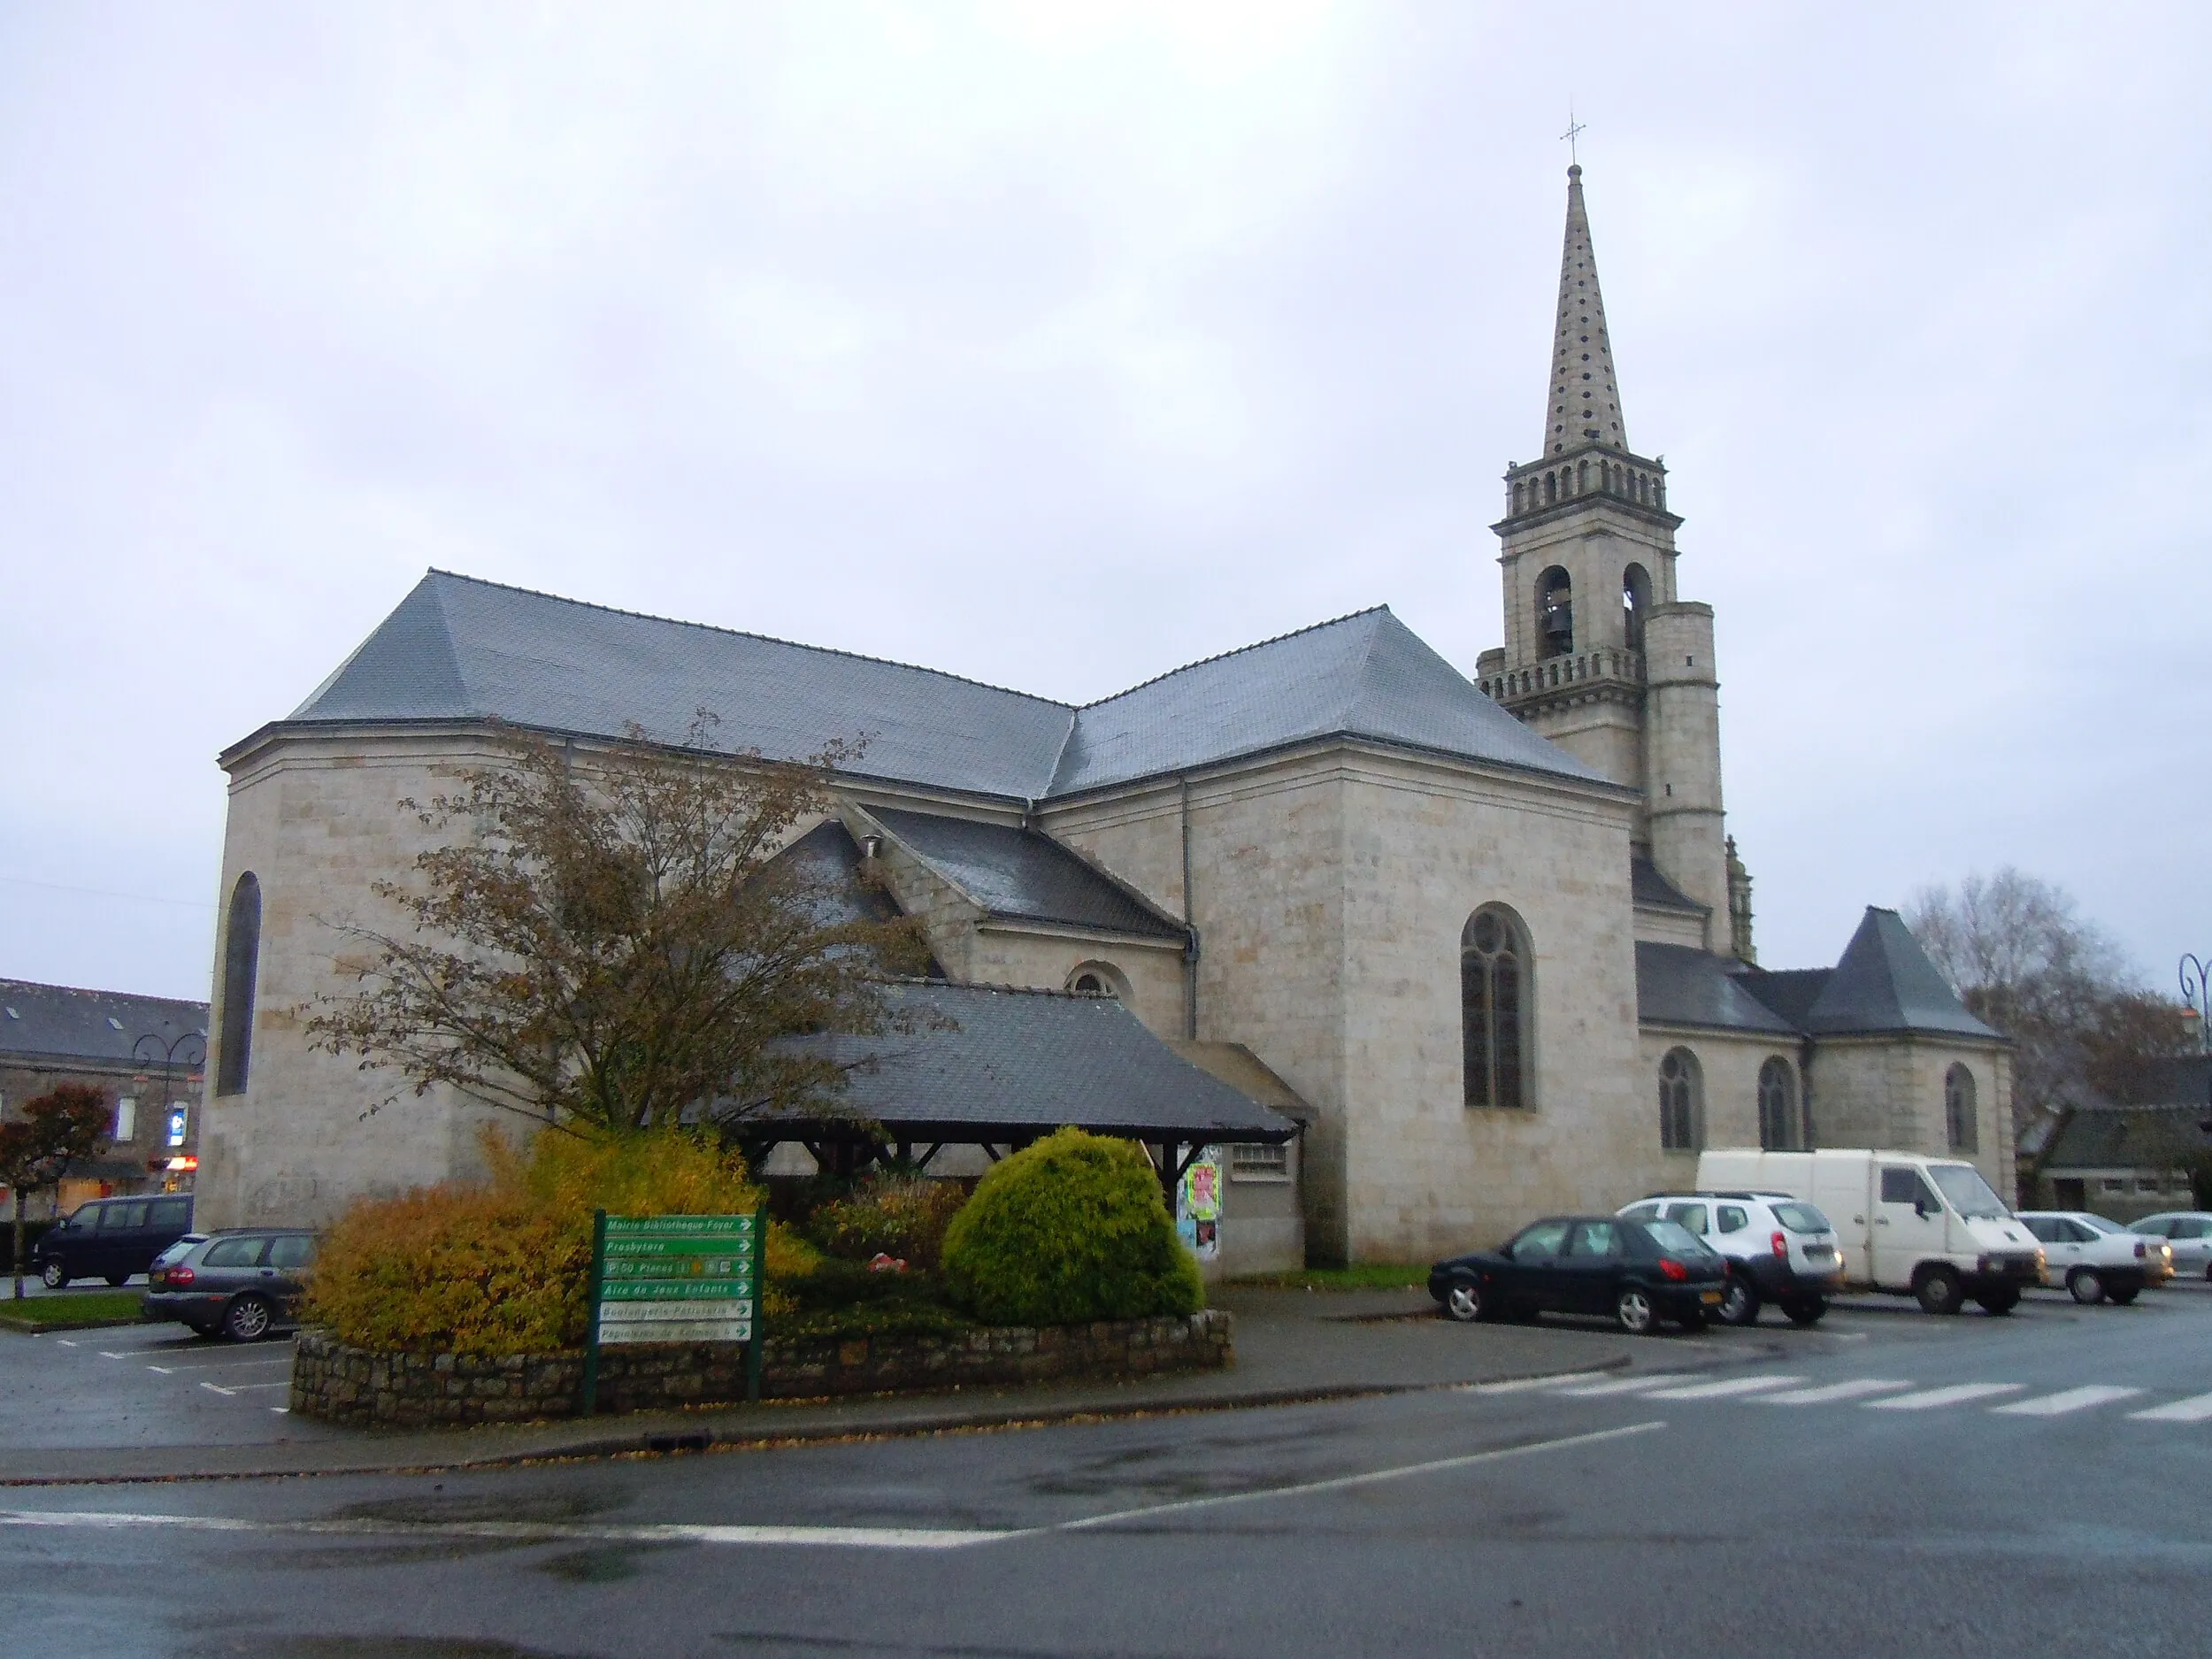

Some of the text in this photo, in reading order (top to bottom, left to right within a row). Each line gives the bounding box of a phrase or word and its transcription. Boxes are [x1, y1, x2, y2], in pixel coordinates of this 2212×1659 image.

[607, 1221, 641, 1230] Mairie
[707, 1220, 734, 1231] Foyer
[604, 1286, 629, 1295] Aire
[653, 1285, 679, 1294] Jeux
[685, 1283, 729, 1294] Enfants
